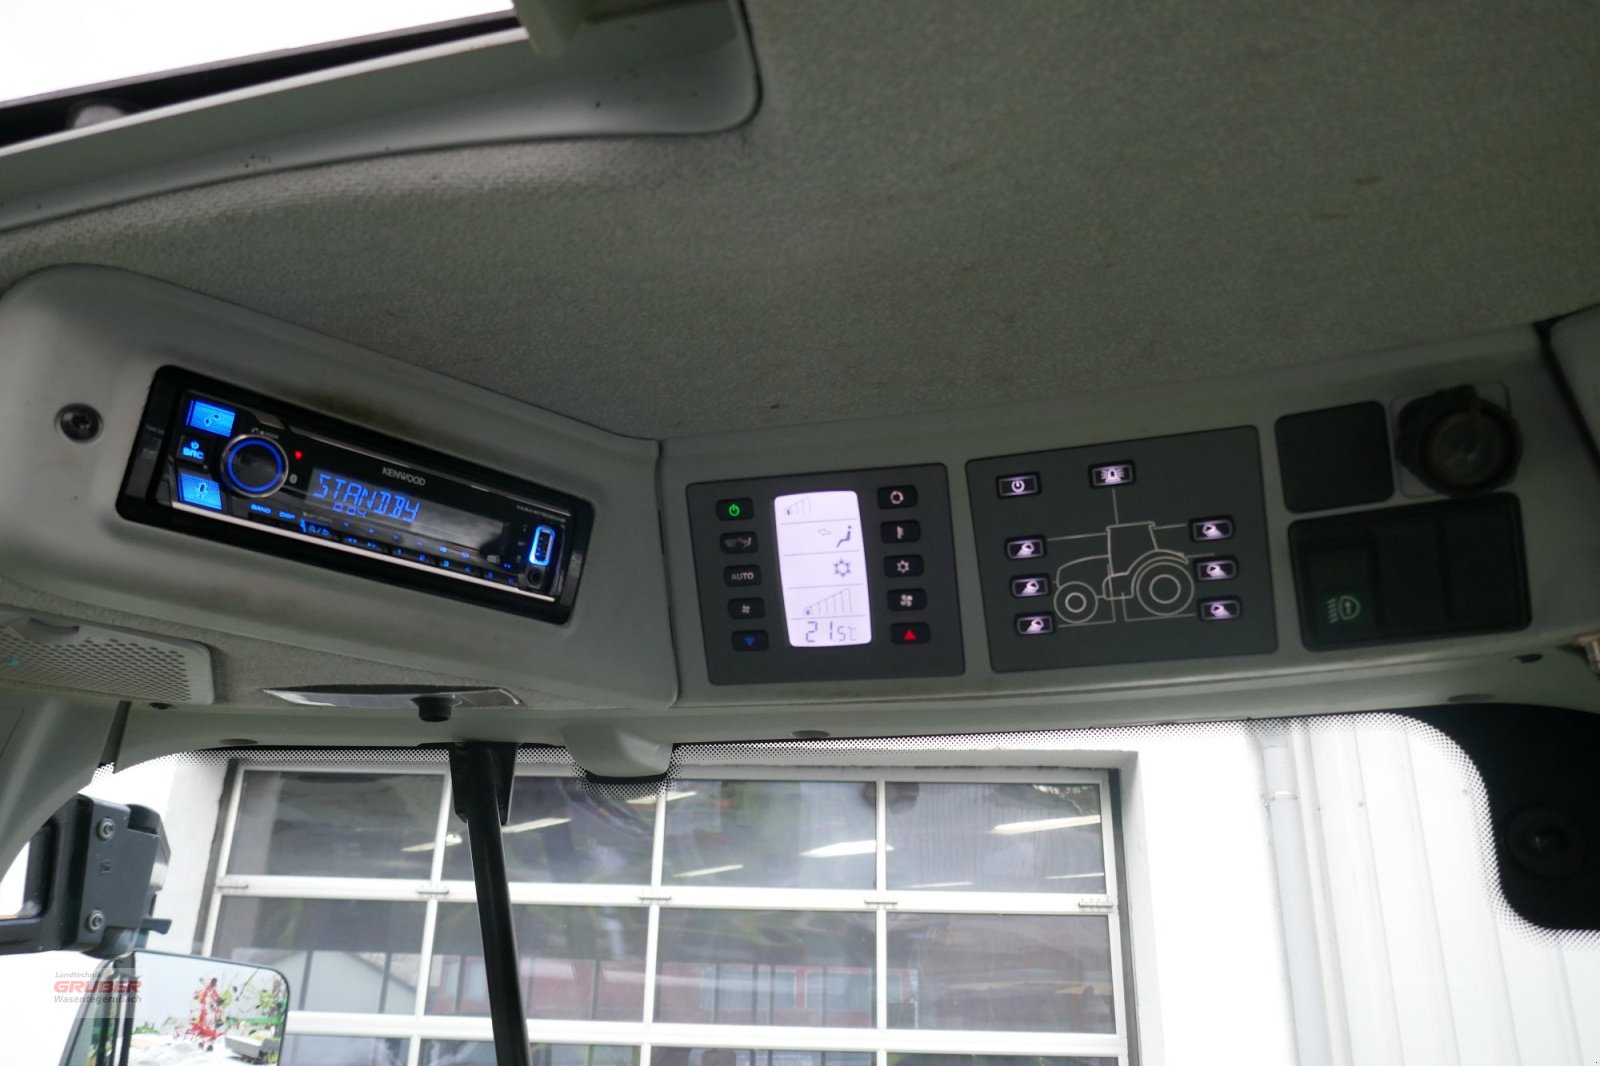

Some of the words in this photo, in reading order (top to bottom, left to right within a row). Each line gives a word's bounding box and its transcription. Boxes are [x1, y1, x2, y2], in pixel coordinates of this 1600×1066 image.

[382, 466, 426, 487] KENWOOD
[312, 473, 420, 524] STANDBY
[250, 503, 272, 514] BAND
[731, 571, 755, 581] AUTO
